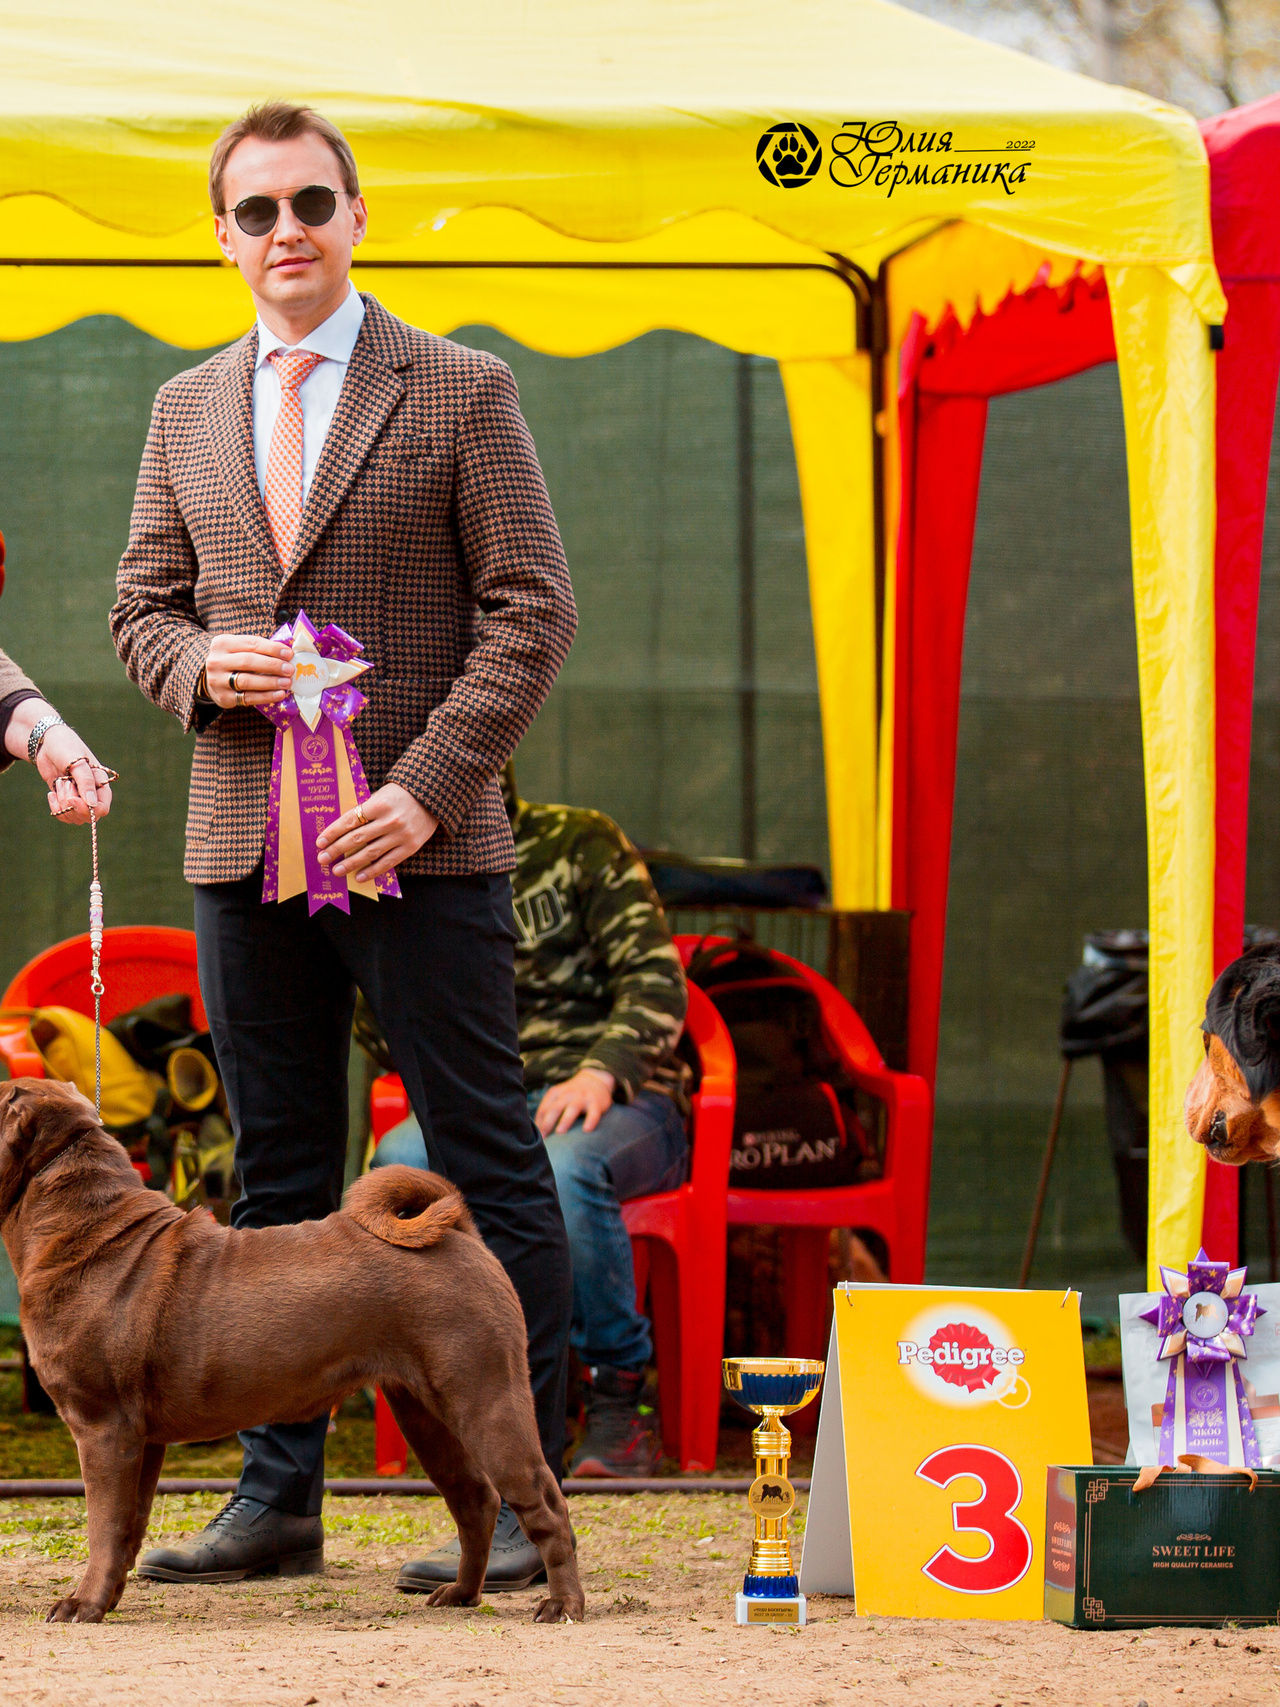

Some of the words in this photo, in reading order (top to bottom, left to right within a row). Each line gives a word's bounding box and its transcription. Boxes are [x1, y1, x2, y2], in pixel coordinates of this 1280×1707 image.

[762, 1138, 836, 1168] PLAN
[897, 1340, 1025, 1370] Pedigree
[914, 1443, 1034, 1595] 3
[1152, 1545, 1201, 1557] SWEET
[1204, 1545, 1236, 1557] LIFE
